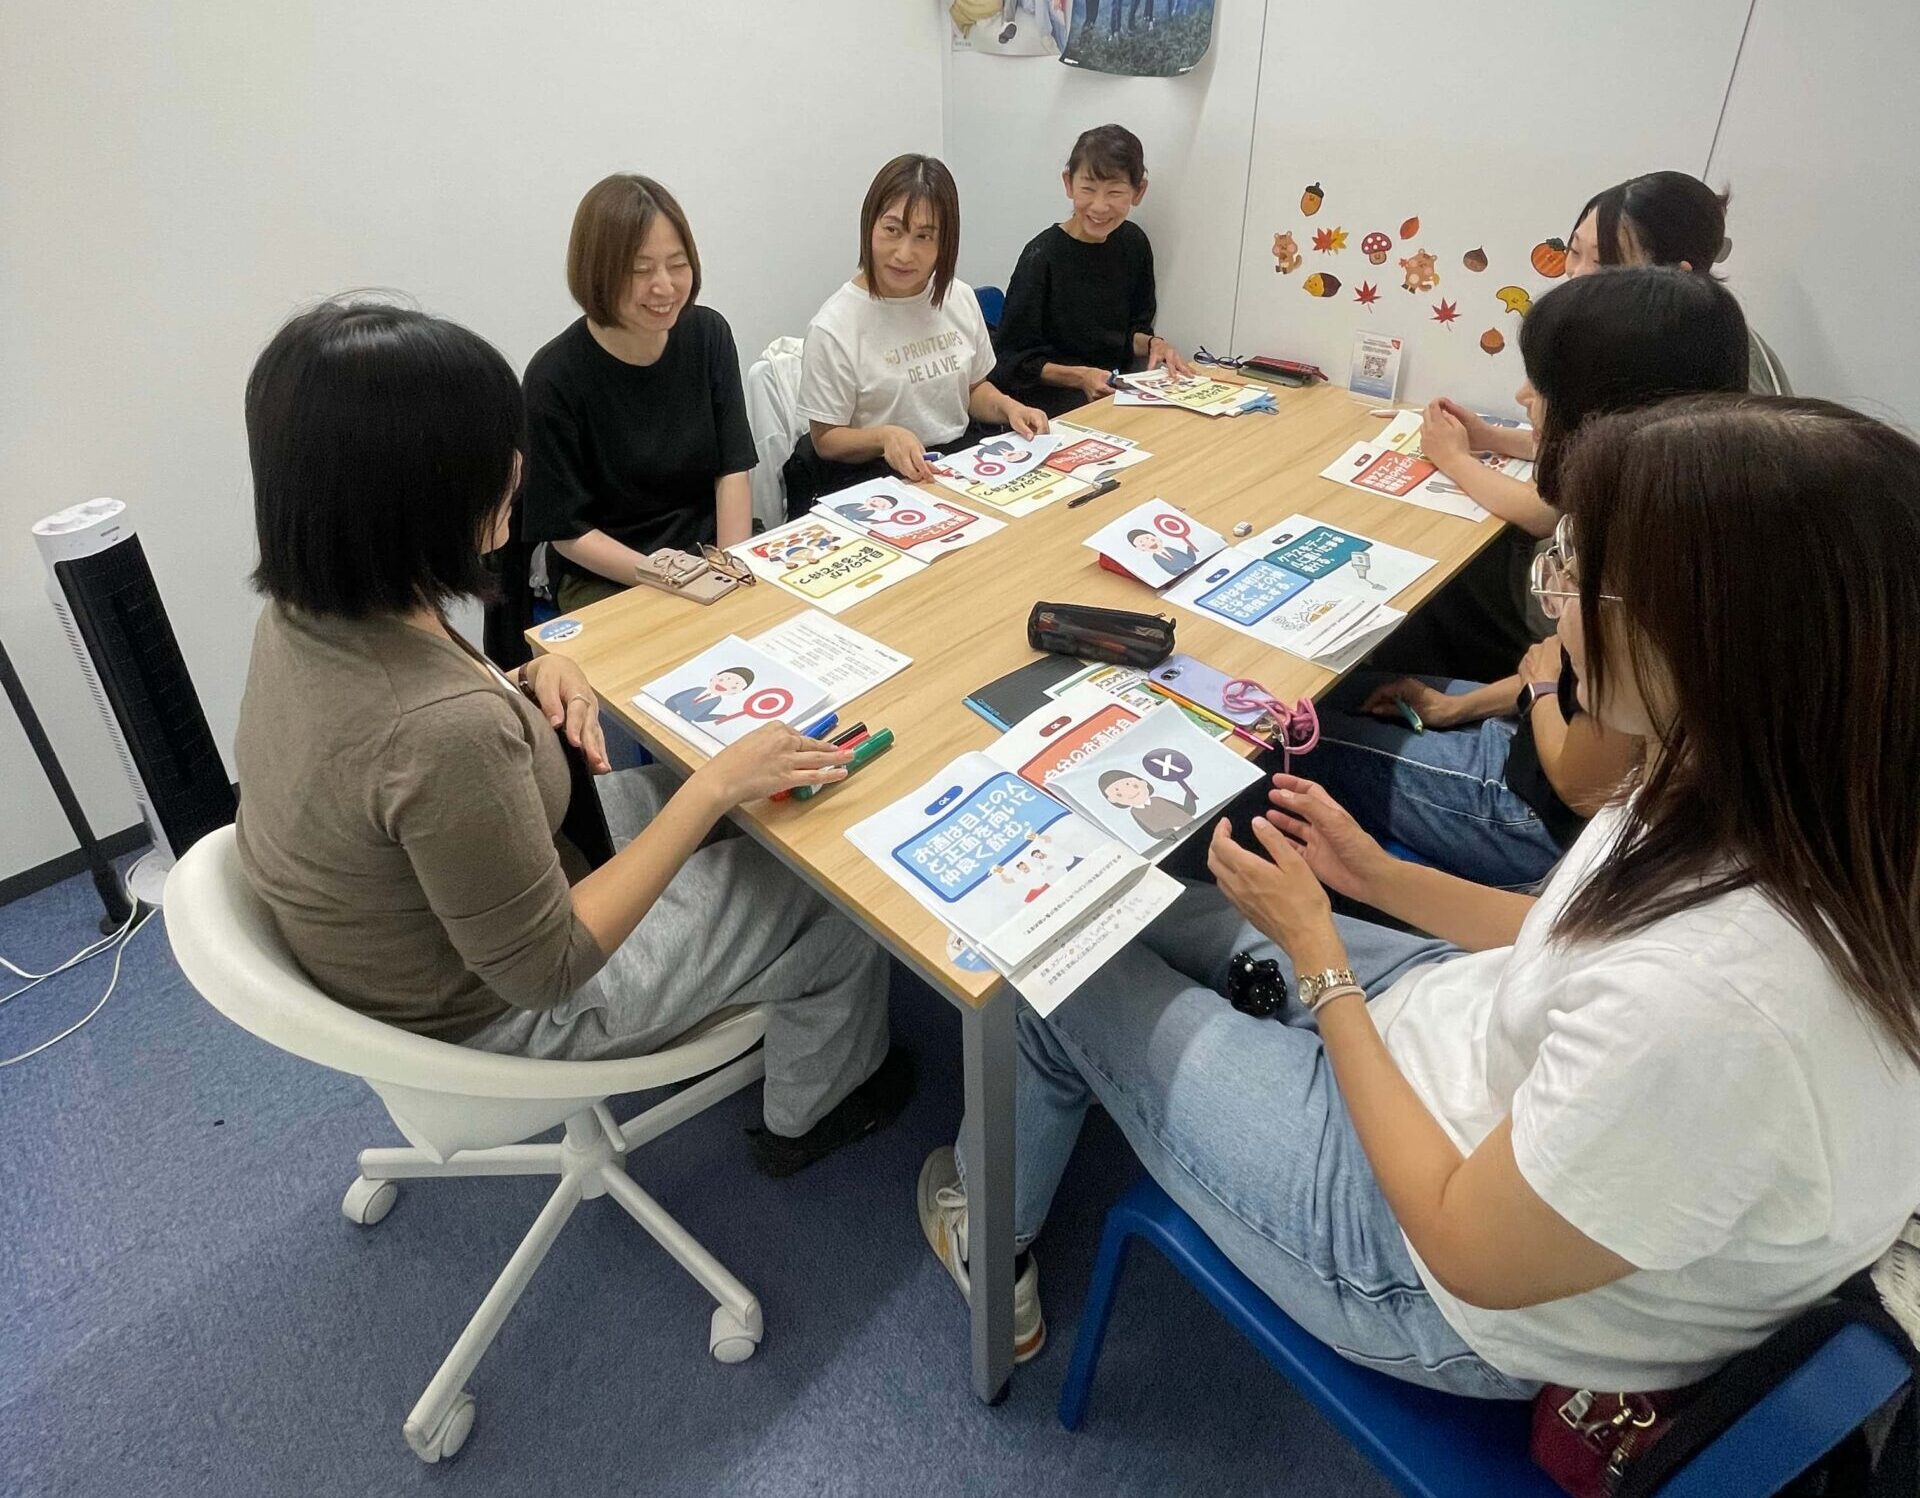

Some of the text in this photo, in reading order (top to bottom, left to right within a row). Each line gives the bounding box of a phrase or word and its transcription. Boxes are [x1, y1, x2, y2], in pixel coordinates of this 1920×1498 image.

[902, 331, 963, 361] PRINTEMPS
[908, 355, 960, 384] DE LA VIE
[792, 546, 874, 585] 食べるまで待つ。
[830, 550, 884, 579] 目上の人が
[912, 780, 1024, 864] お酒は目上の人
[928, 789, 1037, 874] と正面を向いて
[940, 820, 1030, 887] 仲良く飲む。
